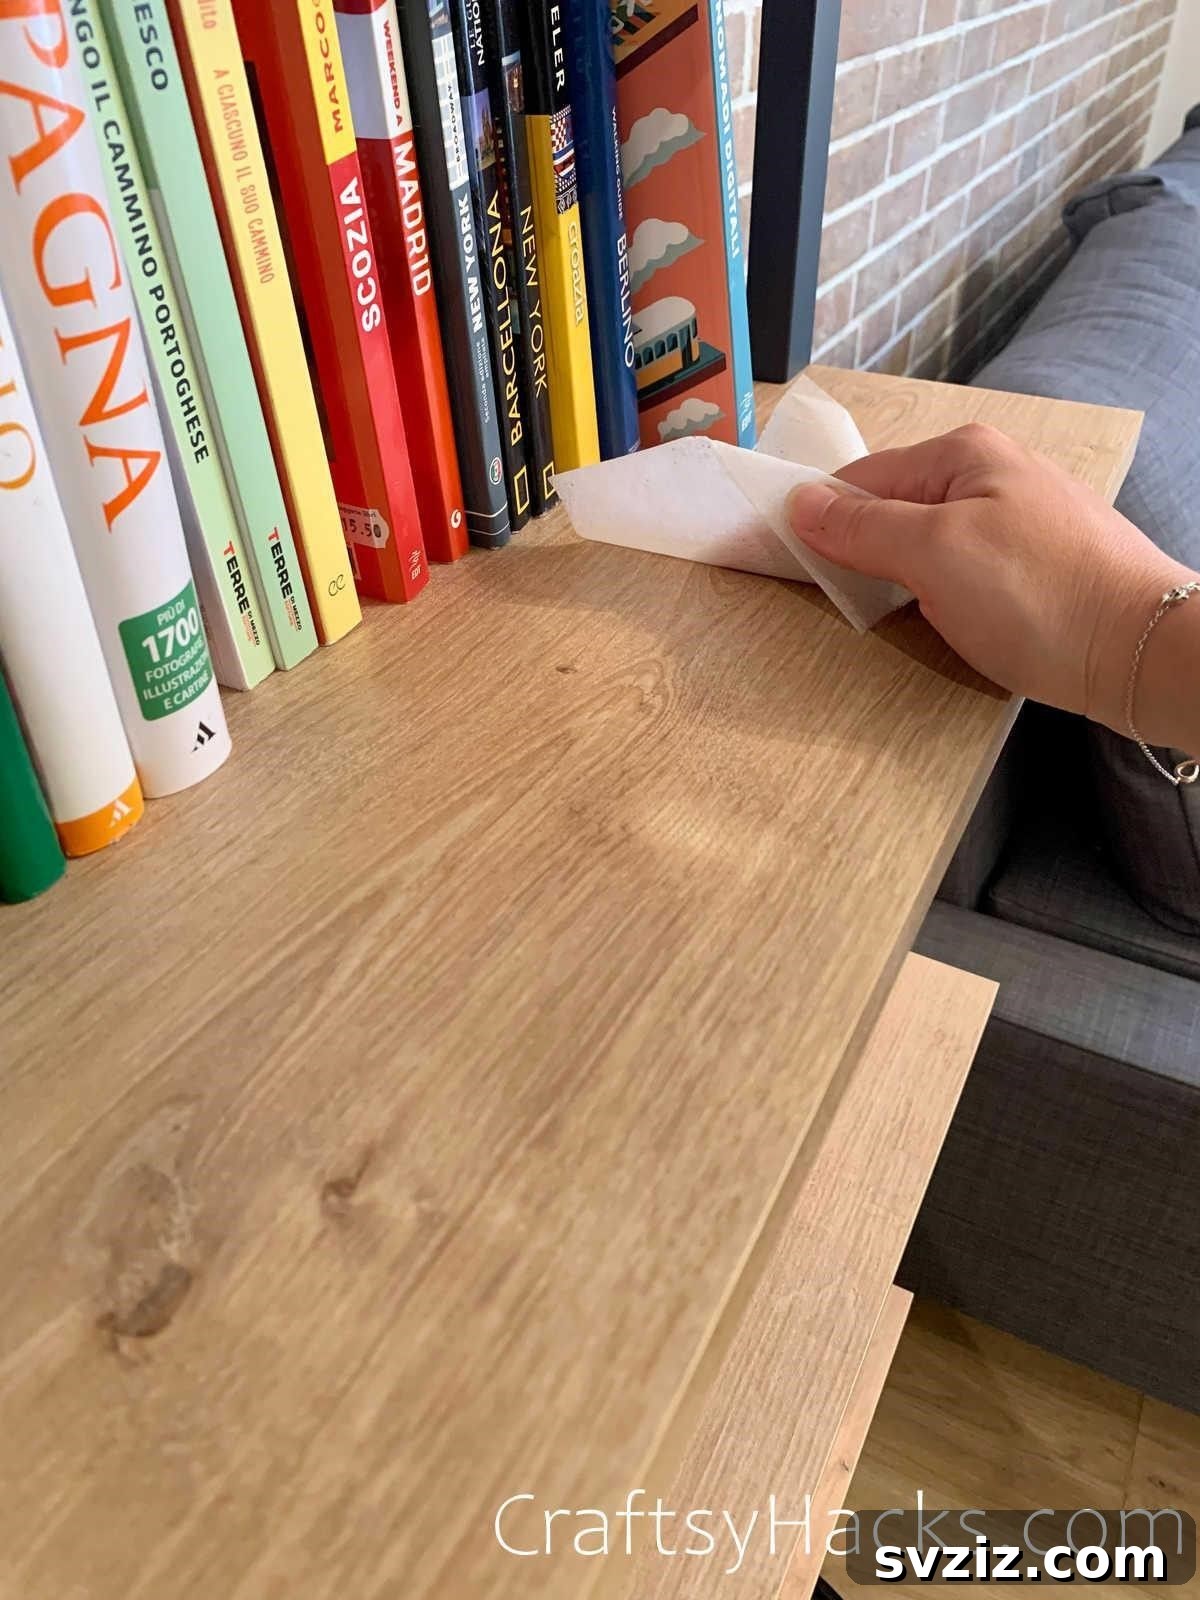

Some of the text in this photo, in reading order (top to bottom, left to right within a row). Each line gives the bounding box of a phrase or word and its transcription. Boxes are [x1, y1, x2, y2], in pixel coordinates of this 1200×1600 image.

[315, 11, 343, 133] MARCO
[383, 19, 403, 127] WEEKEND A
[715, 0, 740, 259] NOMADI DIGITALI
[213, 68, 276, 285] A CIASCUNO IL SUO CAMMINO
[393, 140, 432, 297] MADRID
[91, 79, 111, 112] IL
[103, 120, 158, 278] CAMMINO
[149, 284, 209, 464] PORTOGHESE
[339, 176, 381, 332] SCOZIA
[458, 193, 483, 334] NEW YORK
[487, 190, 523, 446] BARCELLONA
[520, 205, 548, 399] NEW YORK
[617, 232, 635, 368] BERLINO
[156, 606, 176, 627] PIÙ
[223, 540, 250, 615] TERRE
[268, 526, 294, 600] TERRE
[141, 606, 200, 664] 1700
[163, 670, 210, 711] E CARTINE
